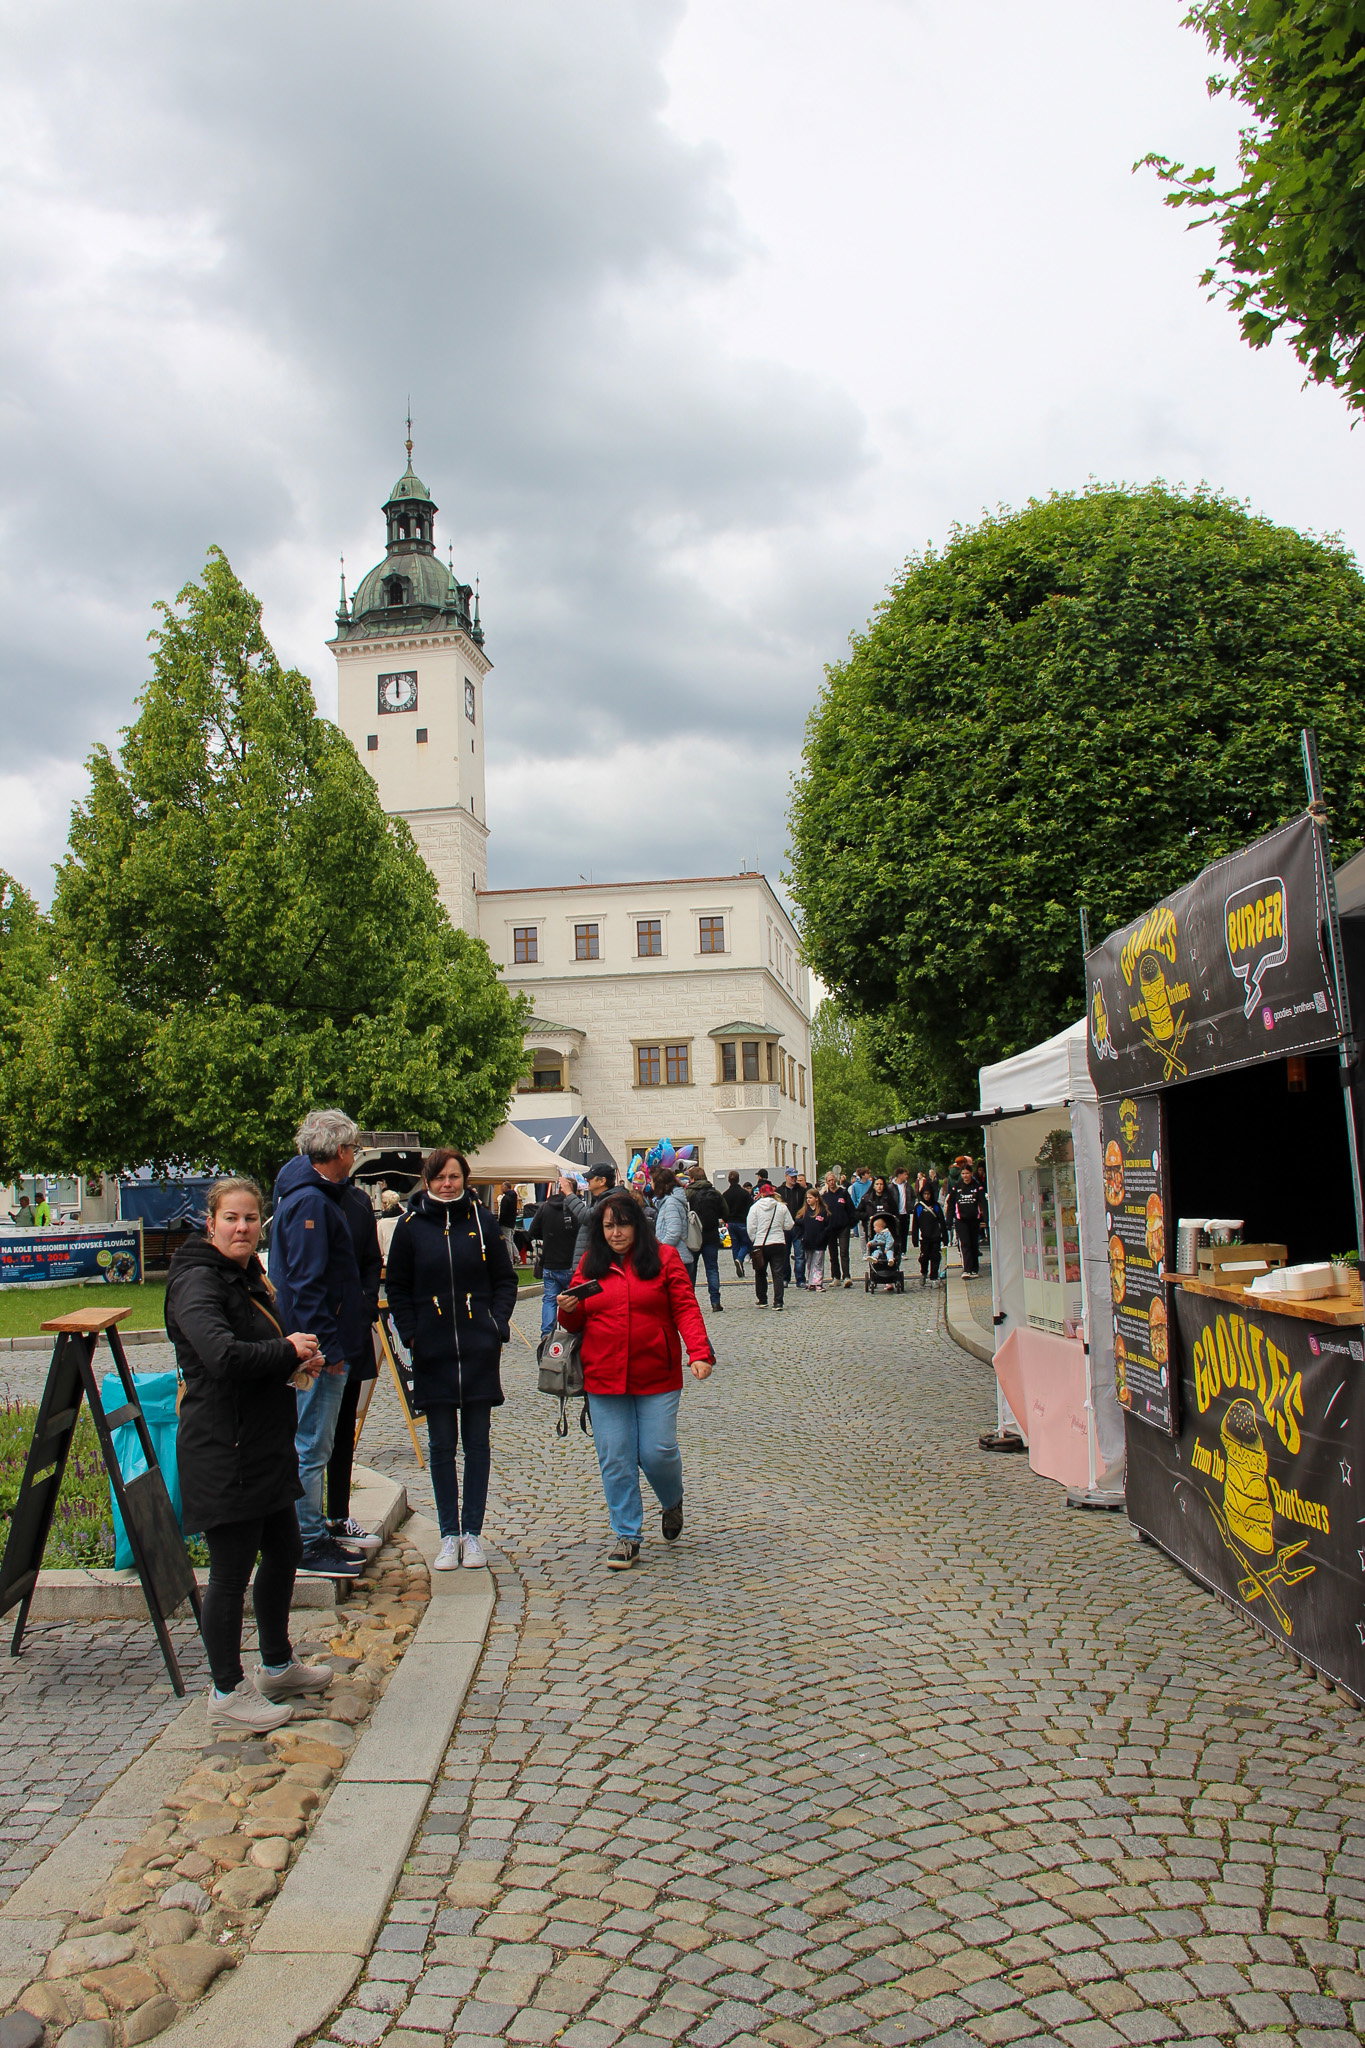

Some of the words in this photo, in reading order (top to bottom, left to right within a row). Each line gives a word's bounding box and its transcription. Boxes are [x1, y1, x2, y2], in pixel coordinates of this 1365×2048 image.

[1120, 906, 1177, 987] GOODIES
[1228, 891, 1283, 954] BURGER
[1, 1246, 12, 1254] NA
[33, 1244, 68, 1252] REGIONEM
[69, 1240, 103, 1250] KYJOVSKÉ
[103, 1238, 136, 1248] SLOVÁCKO
[1192, 1312, 1304, 1455] GOODIES
[1191, 1436, 1212, 1476] from
[1211, 1449, 1225, 1483] the
[1268, 1476, 1330, 1535] Brothers
